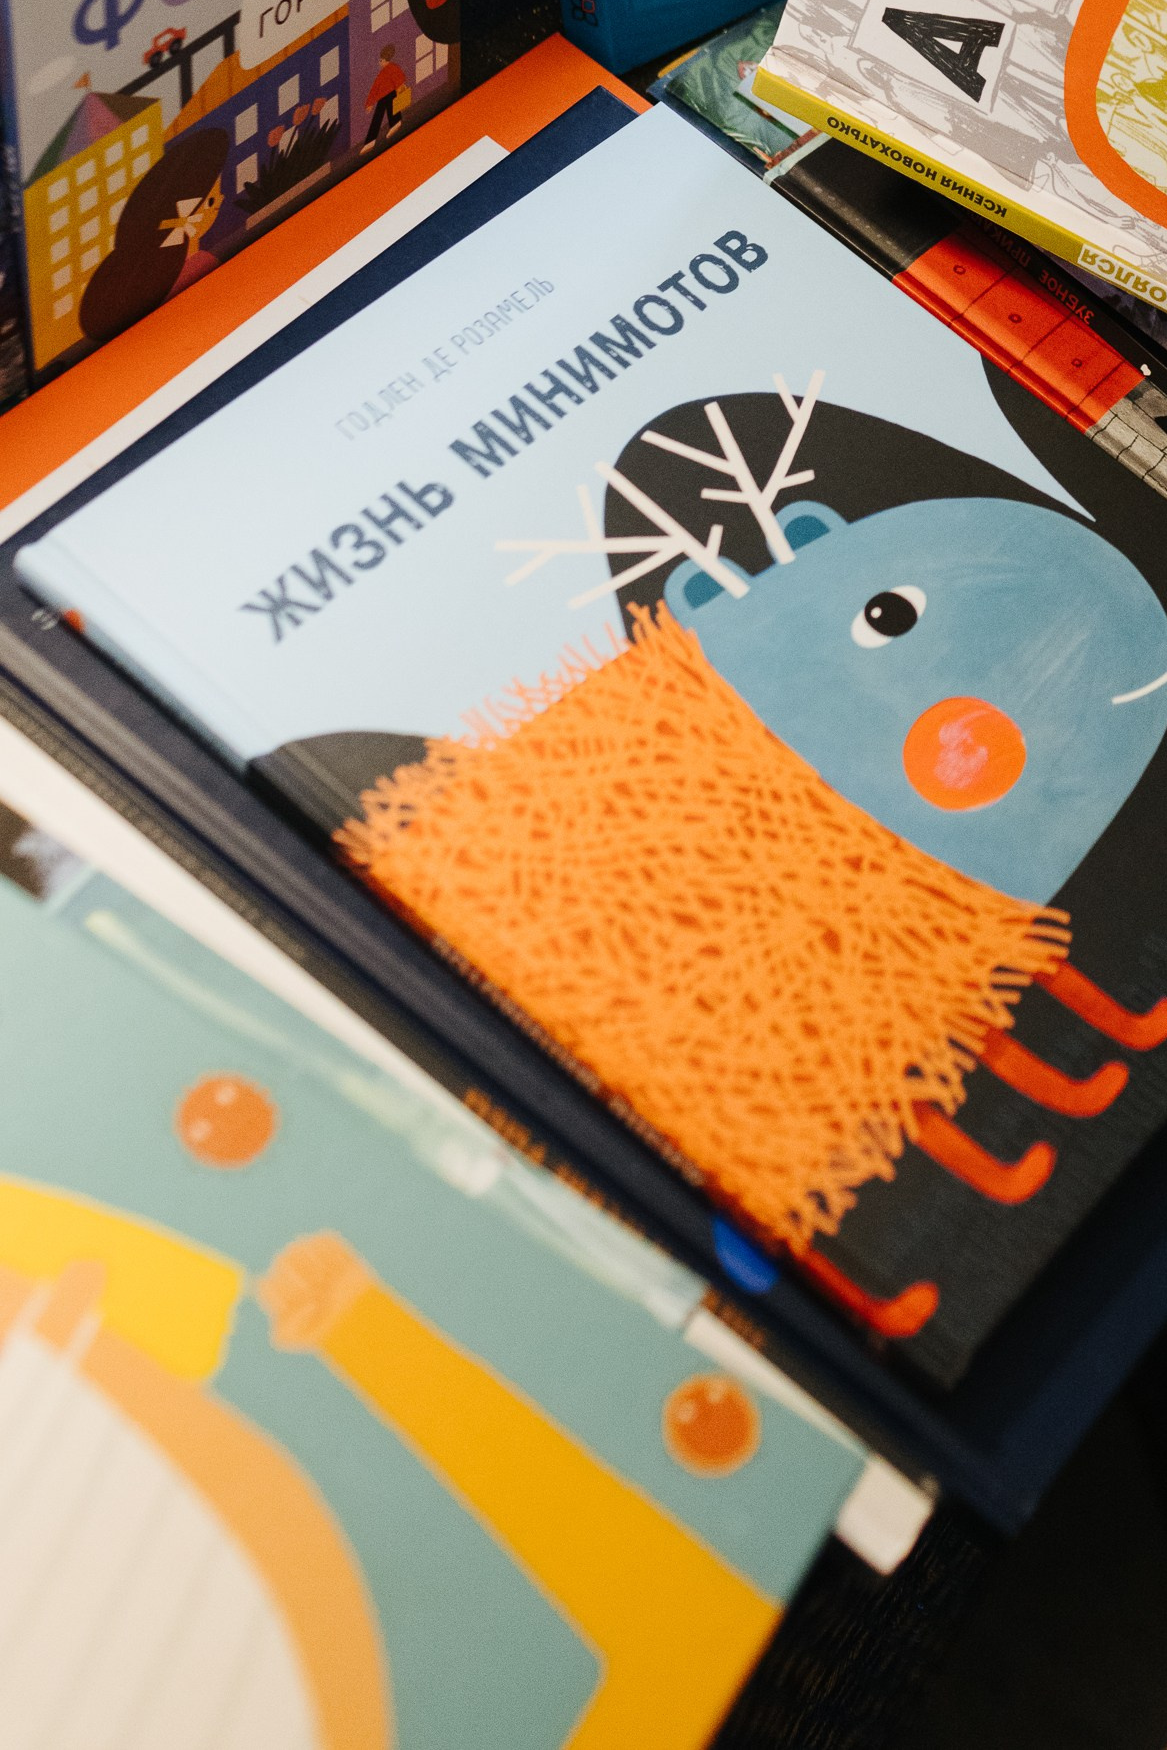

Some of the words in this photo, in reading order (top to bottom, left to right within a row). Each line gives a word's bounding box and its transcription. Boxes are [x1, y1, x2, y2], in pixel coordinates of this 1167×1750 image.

[826, 115, 938, 192] НОВОХАТЬКО
[940, 172, 1008, 219] КСЕНИЯ
[422, 347, 458, 383] ДЕ
[450, 277, 555, 355] РОЗАМЕЛЬ
[1039, 269, 1095, 324] ЗУБНОЕ
[239, 480, 456, 645] ЖИЗНЬ
[449, 229, 769, 479] МИНИМОТОВ
